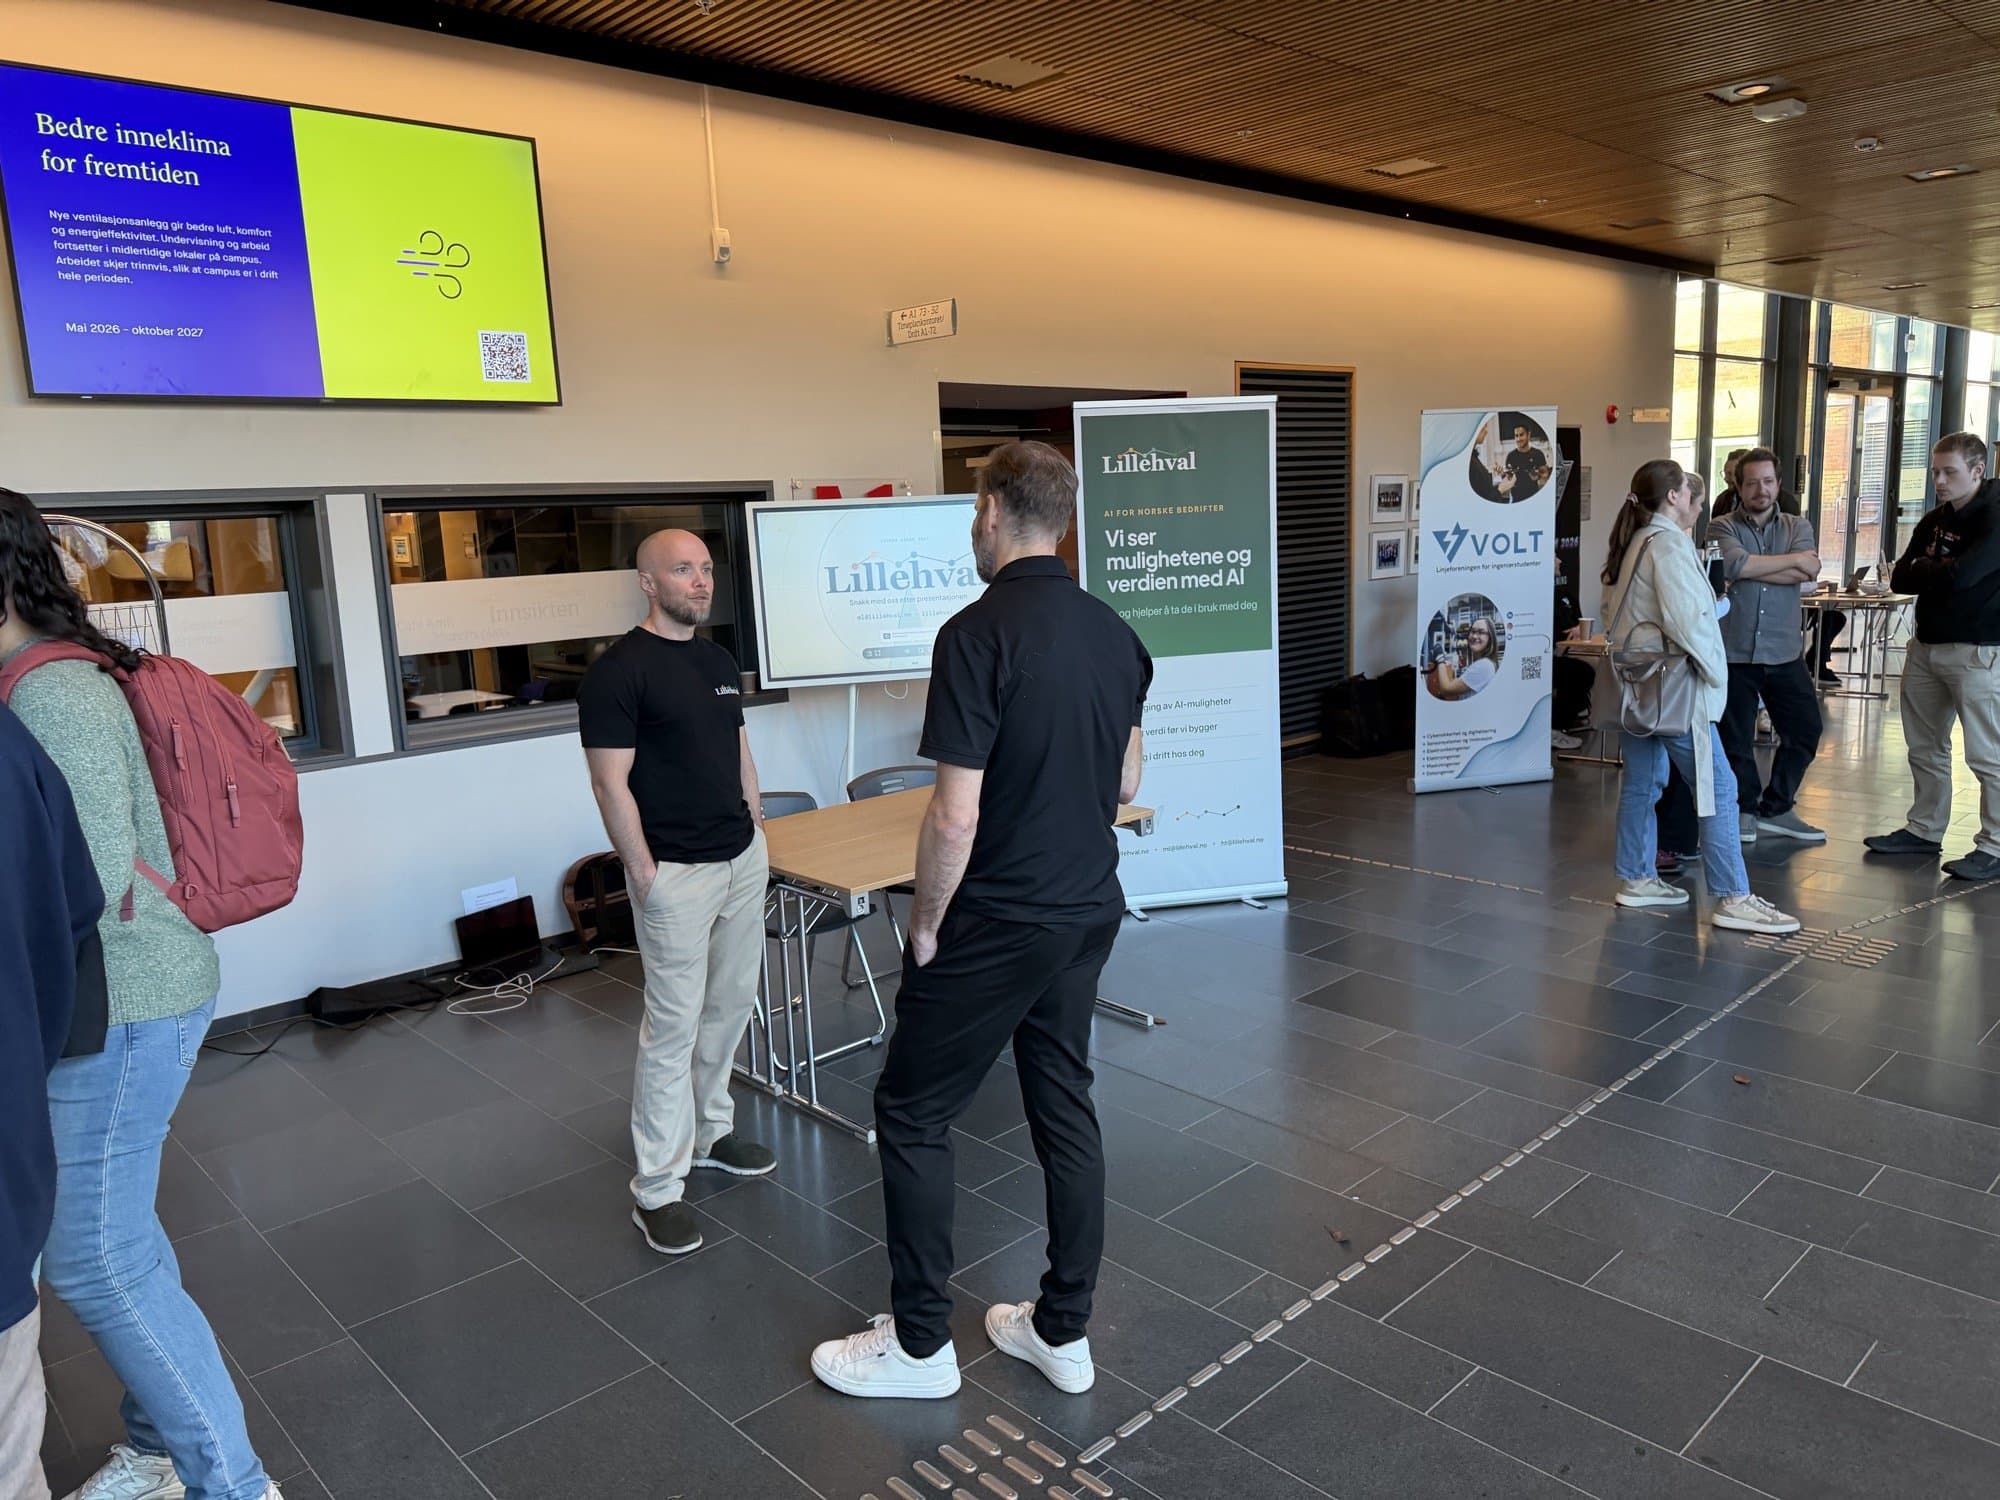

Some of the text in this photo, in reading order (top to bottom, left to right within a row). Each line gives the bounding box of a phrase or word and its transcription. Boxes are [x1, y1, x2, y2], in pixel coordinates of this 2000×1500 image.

[35, 112, 231, 157] Bedre inneklima
[41, 148, 200, 186] for fremtiden
[49, 209, 70, 221] Nye
[72, 213, 169, 230] ventilasjonsanlegg
[171, 221, 183, 231] gir
[186, 222, 214, 232] bedre
[236, 226, 272, 237] komfort
[51, 227, 270, 251] og energieffektivitet. Undervisning og arbeid
[53, 240, 102, 252] fortsetter
[112, 245, 171, 259] midlertidige
[174, 250, 206, 260] lokaler
[209, 253, 220, 262] på
[222, 254, 262, 264] campus.
[56, 256, 100, 267] Arbeidet
[103, 259, 128, 270] skjer
[173, 264, 189, 273] slik
[192, 266, 202, 274] at
[204, 267, 240, 277] campus
[260, 270, 279, 279] drift
[58, 271, 133, 284] hele perioden.
[65, 323, 87, 333] Mai
[89, 323, 121, 334] 2026
[131, 325, 174, 336] oktober
[177, 327, 204, 337] 2027
[1101, 451, 1197, 474] Lillehval
[1116, 509, 1135, 517] FOR
[1138, 507, 1174, 516] NORSKE
[1176, 504, 1224, 514] BEDRIFTER
[1105, 529, 1157, 547] Vi ser
[1470, 530, 1544, 556] VOLT
[1106, 549, 1251, 573] mulighetene og
[824, 559, 988, 594] Lillehva
[1107, 567, 1245, 593] verdien med AI
[1119, 609, 1131, 620] og
[1132, 607, 1162, 619] hjelper
[1164, 605, 1170, 615] å
[1171, 606, 1180, 614] ta
[1181, 604, 1193, 614] de
[1198, 602, 1218, 613] bruk
[1219, 601, 1239, 611] med
[1240, 600, 1258, 612] deg
[1143, 702, 1161, 713] ging
[1174, 698, 1232, 709] AI-muligheter
[1145, 726, 1166, 736] verdi
[1180, 724, 1187, 733] vi
[1189, 723, 1217, 734] bygger
[1153, 751, 1170, 760] drift
[1171, 751, 1187, 759] hos
[1188, 748, 1205, 758] deg
